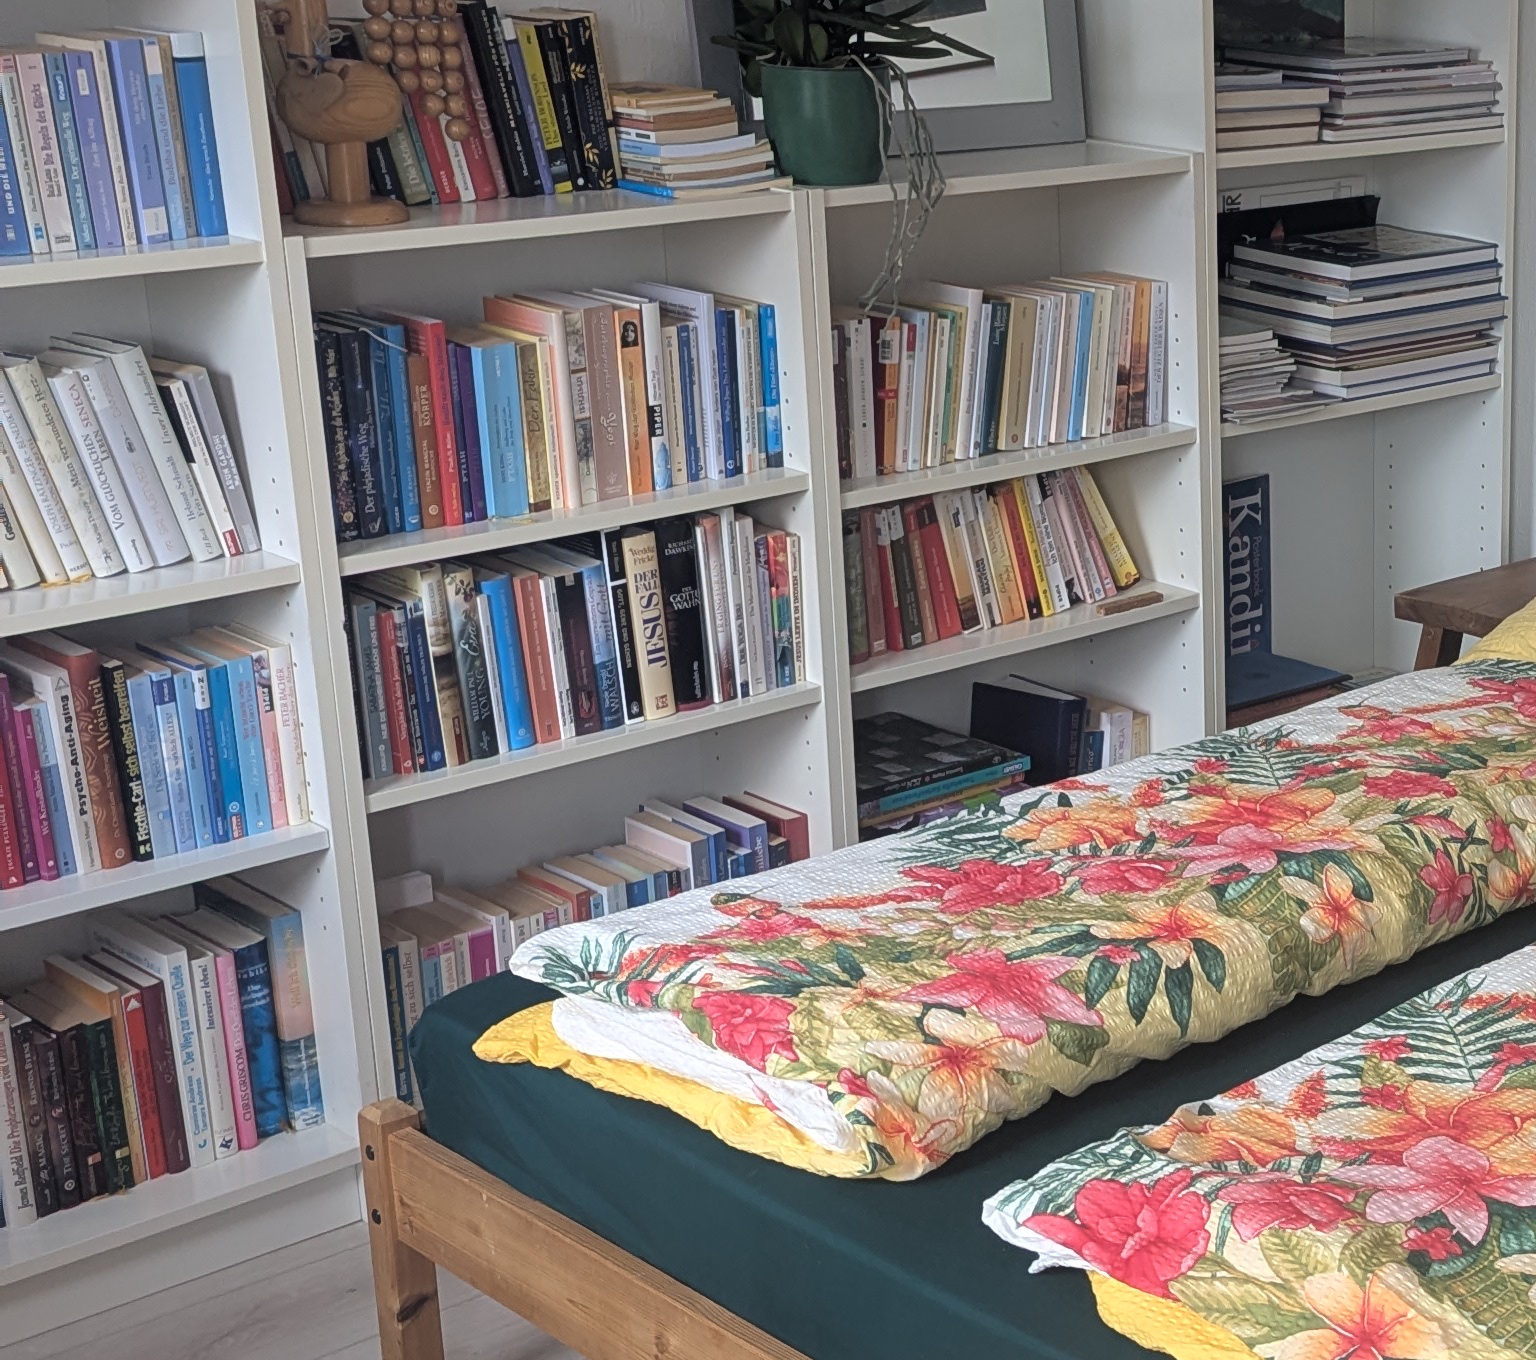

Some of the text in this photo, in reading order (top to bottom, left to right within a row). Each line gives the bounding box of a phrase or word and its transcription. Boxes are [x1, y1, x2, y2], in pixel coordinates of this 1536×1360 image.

[69, 384, 92, 428] SENECA
[82, 434, 125, 530] VOM GLÜCKLICHEN
[634, 569, 658, 581] DER
[1252, 536, 1263, 598] Posterbook
[640, 592, 667, 668] JESUS
[88, 678, 111, 750] Weisheit
[475, 667, 490, 720] YOUNG
[605, 661, 620, 712] WALSCH
[60, 694, 87, 816] Psycho-Anti-Aging
[112, 669, 148, 840] Fischle-Carl sich selbst begreifen
